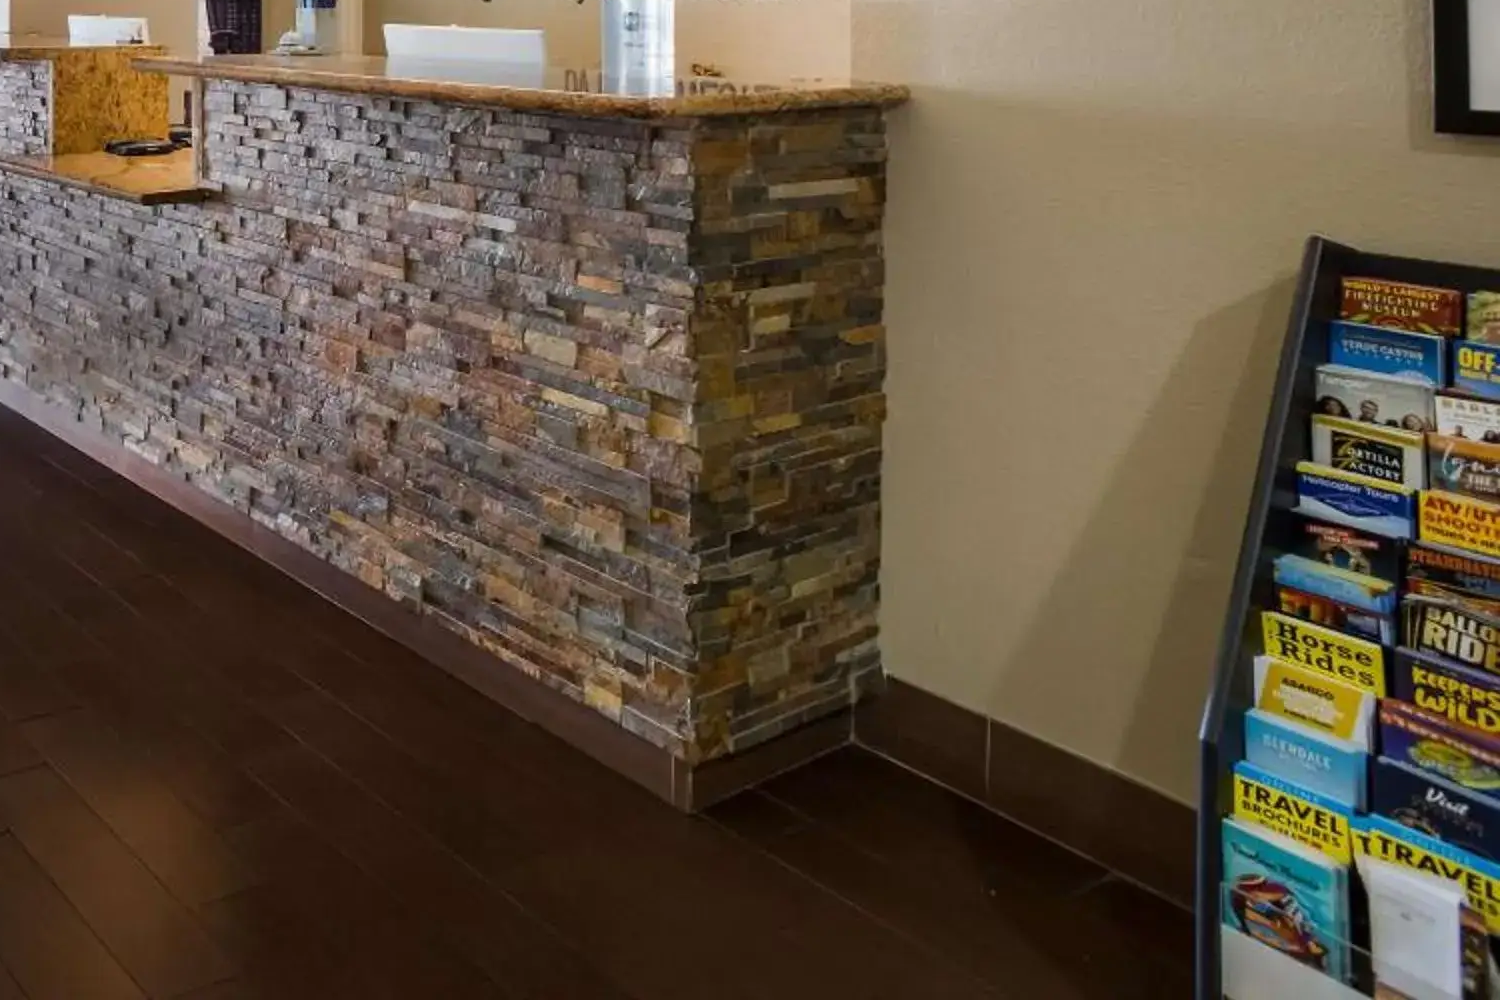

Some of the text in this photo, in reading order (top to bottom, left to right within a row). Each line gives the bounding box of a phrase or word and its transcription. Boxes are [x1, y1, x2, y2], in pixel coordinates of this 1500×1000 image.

[1276, 620, 1373, 667] Horse
[1280, 640, 1375, 687] Rides
[1414, 687, 1500, 732] WILD
[1239, 780, 1344, 837] TRAVEL
[1375, 833, 1500, 904] TRAVEL
